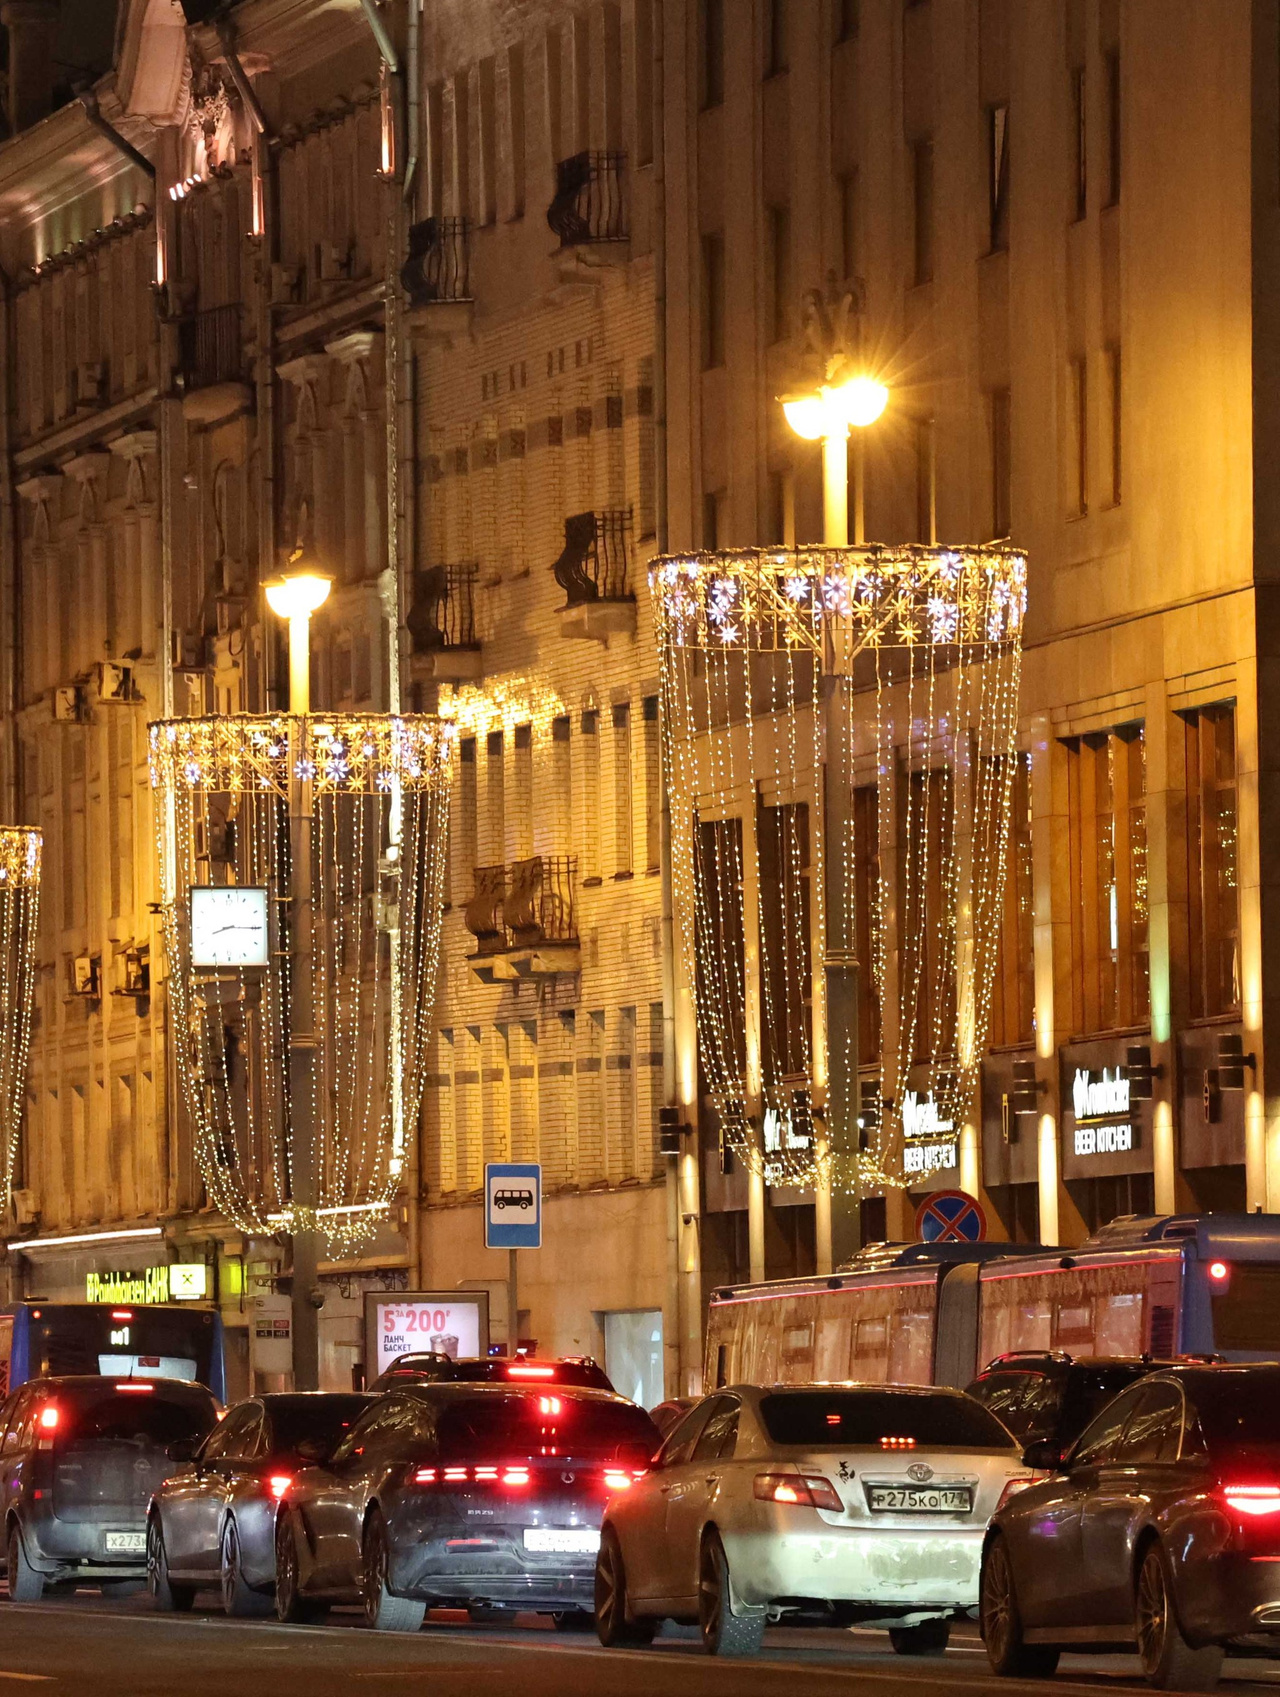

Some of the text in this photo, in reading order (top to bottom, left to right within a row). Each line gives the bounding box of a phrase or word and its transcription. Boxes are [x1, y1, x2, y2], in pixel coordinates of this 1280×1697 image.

[1074, 1124, 1132, 1155] BEER KITCHEN
[145, 1265, 169, 1304] БАНК
[383, 1309, 396, 1333] 5
[383, 1335, 405, 1344] ЛАНЧ
[383, 1343, 412, 1353] БАСКЕТ
